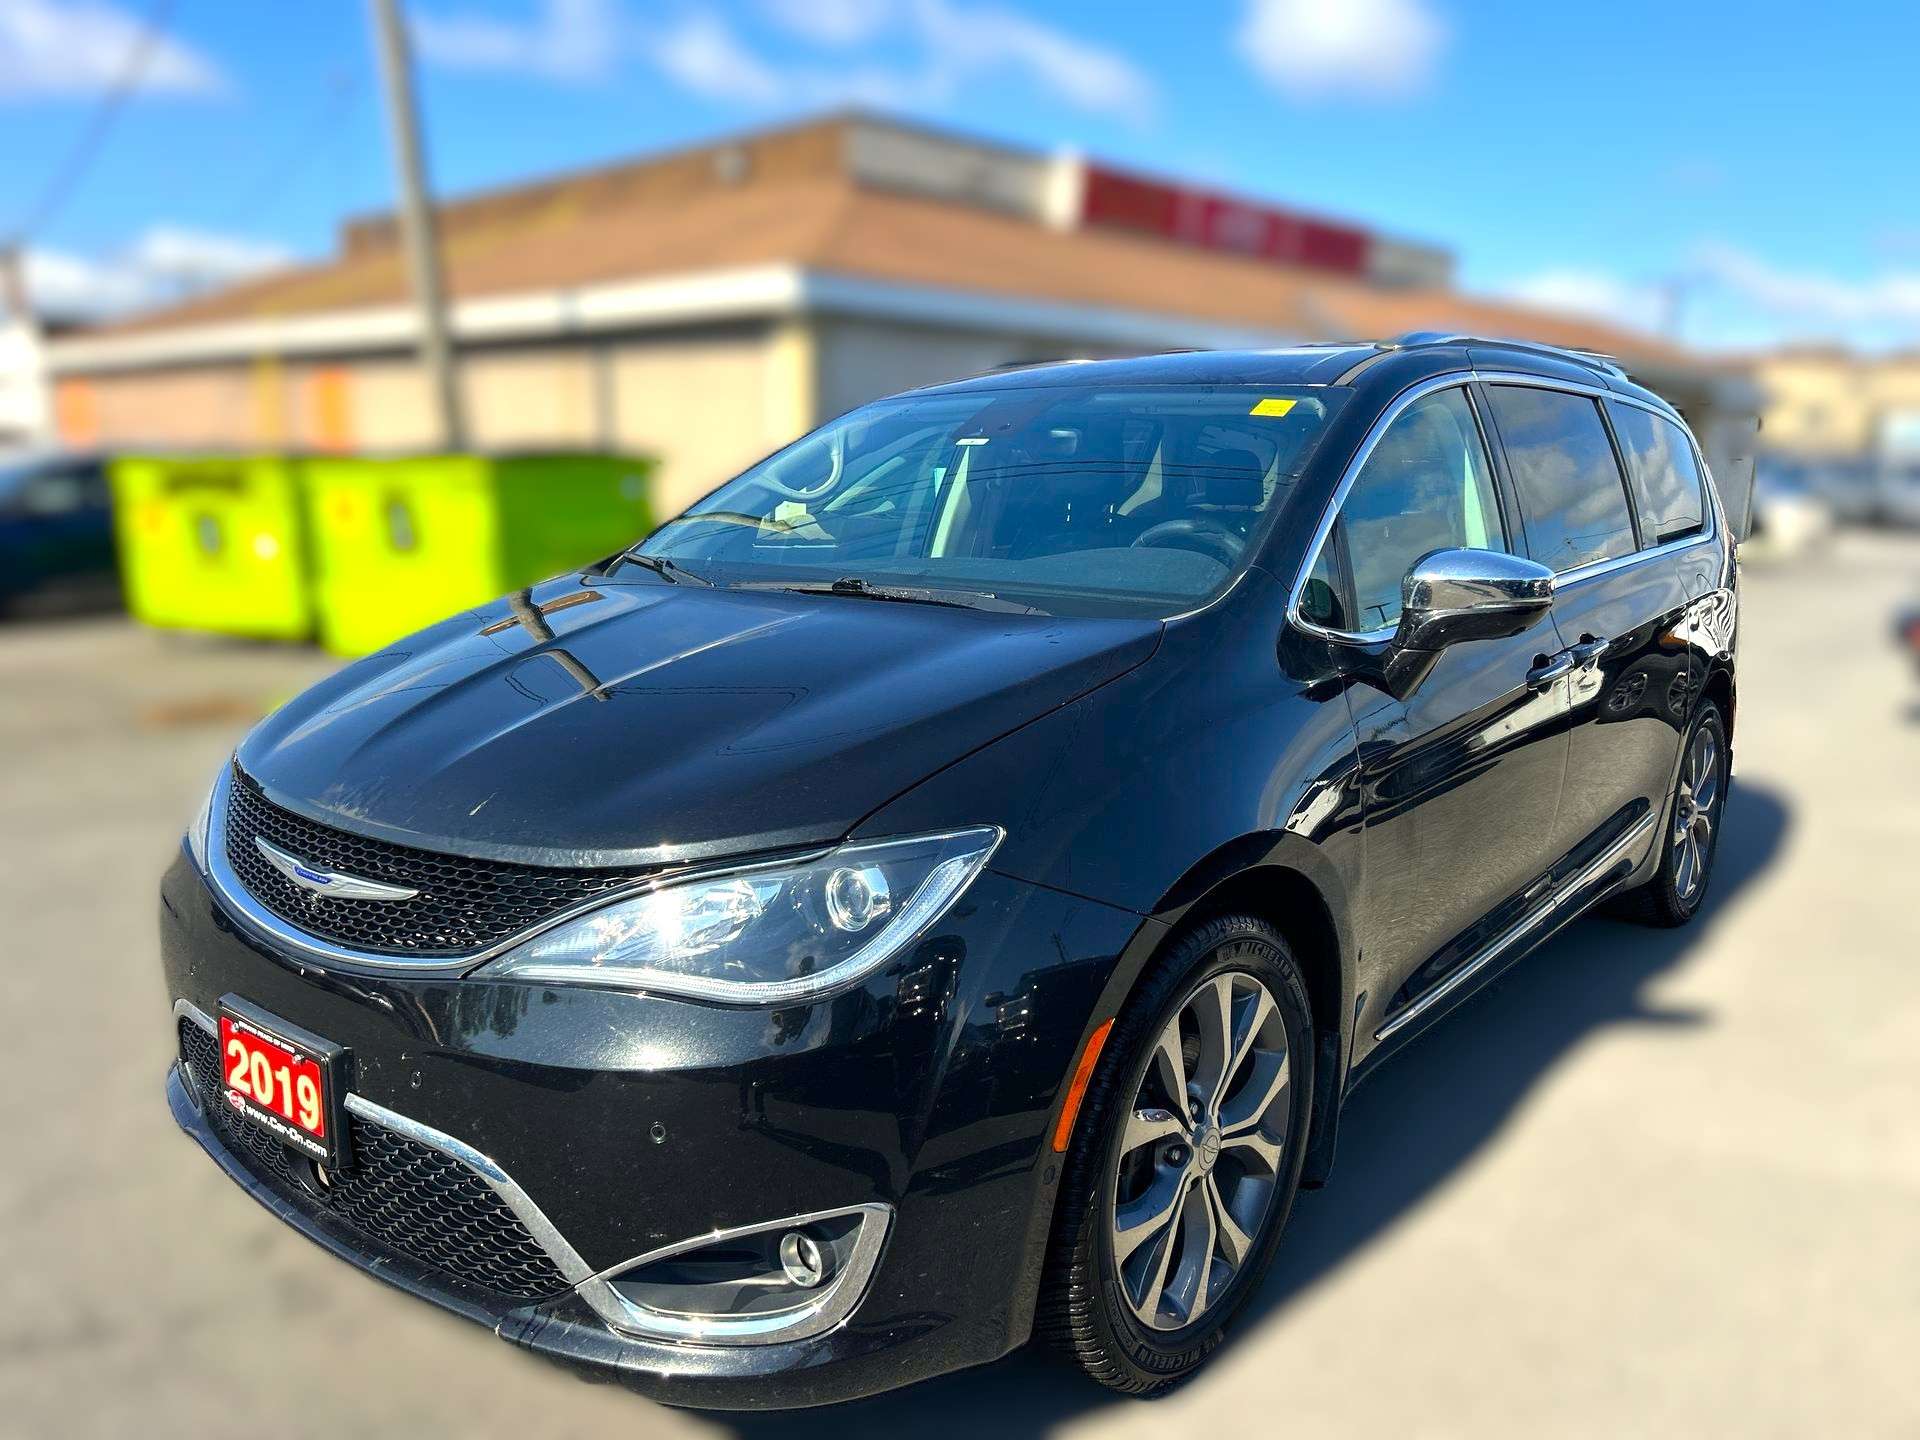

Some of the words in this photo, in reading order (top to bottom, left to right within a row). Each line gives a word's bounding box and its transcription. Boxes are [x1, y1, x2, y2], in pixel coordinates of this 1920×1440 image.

[1239, 942, 1292, 975] MICHELIN
[227, 1039, 320, 1130] 2019
[1139, 1346, 1201, 1369] MICHELIN
